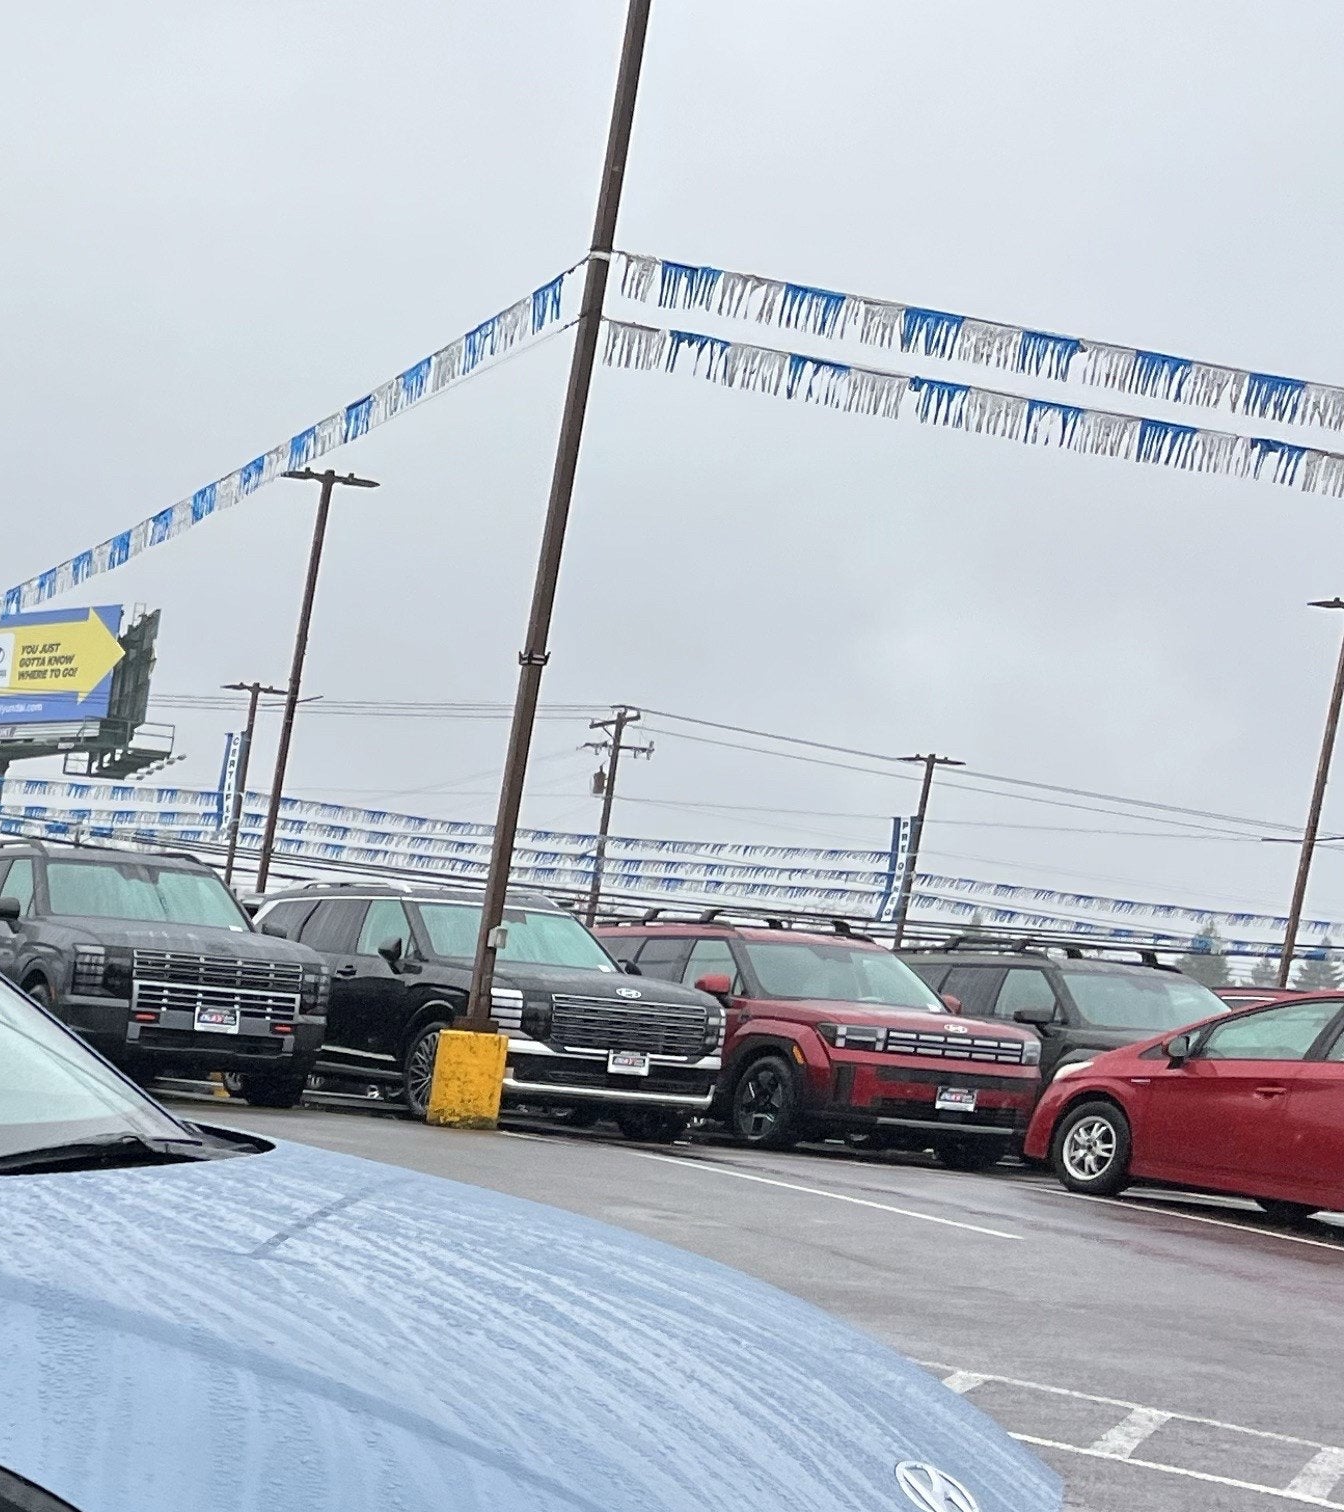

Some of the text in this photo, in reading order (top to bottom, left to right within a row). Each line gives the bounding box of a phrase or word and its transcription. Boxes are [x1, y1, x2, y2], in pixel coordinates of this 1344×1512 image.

[21, 643, 61, 655] YOU JUST
[19, 654, 75, 668] GOTTA KNOW
[17, 667, 79, 680] WHERE TO GO!
